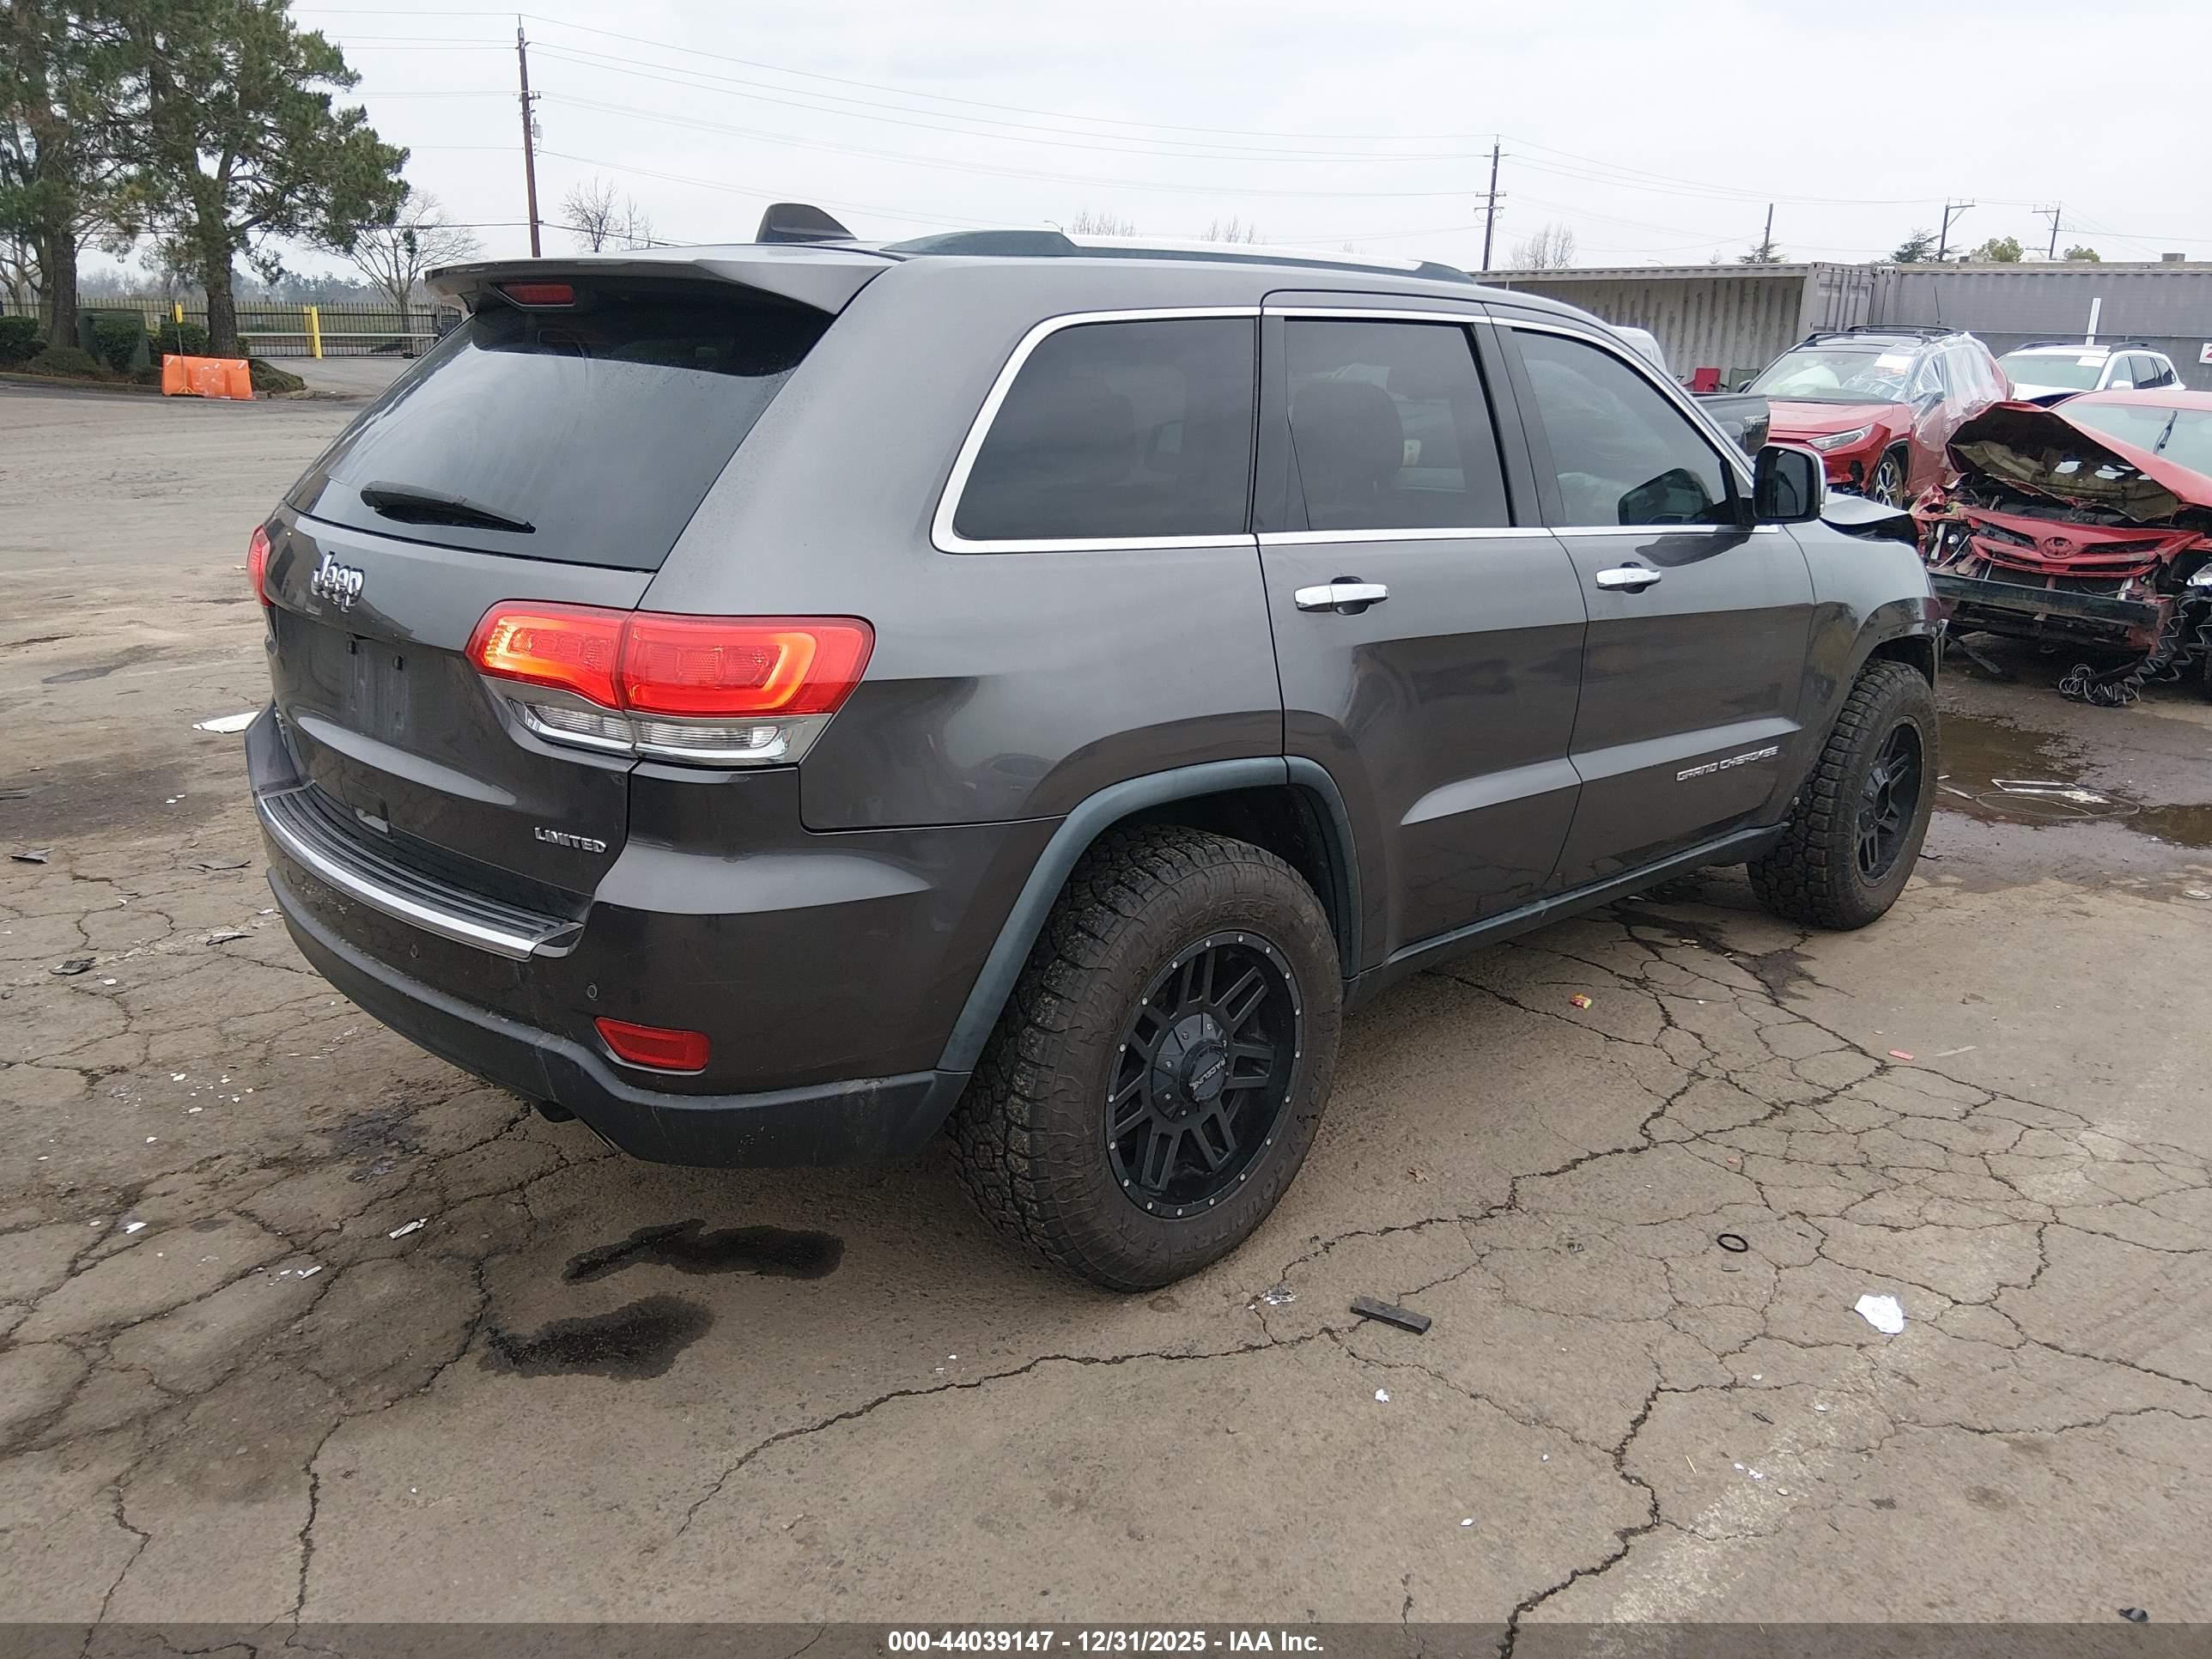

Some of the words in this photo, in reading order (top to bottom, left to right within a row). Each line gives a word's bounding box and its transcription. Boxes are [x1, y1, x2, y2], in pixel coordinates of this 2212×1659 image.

[311, 552, 364, 610] Jeep
[1676, 762, 1718, 781] GRAND
[1718, 745, 1779, 769] CHEROKEE
[534, 827, 606, 854] LIMITED
[1188, 1056, 1226, 1091] RACELINE
